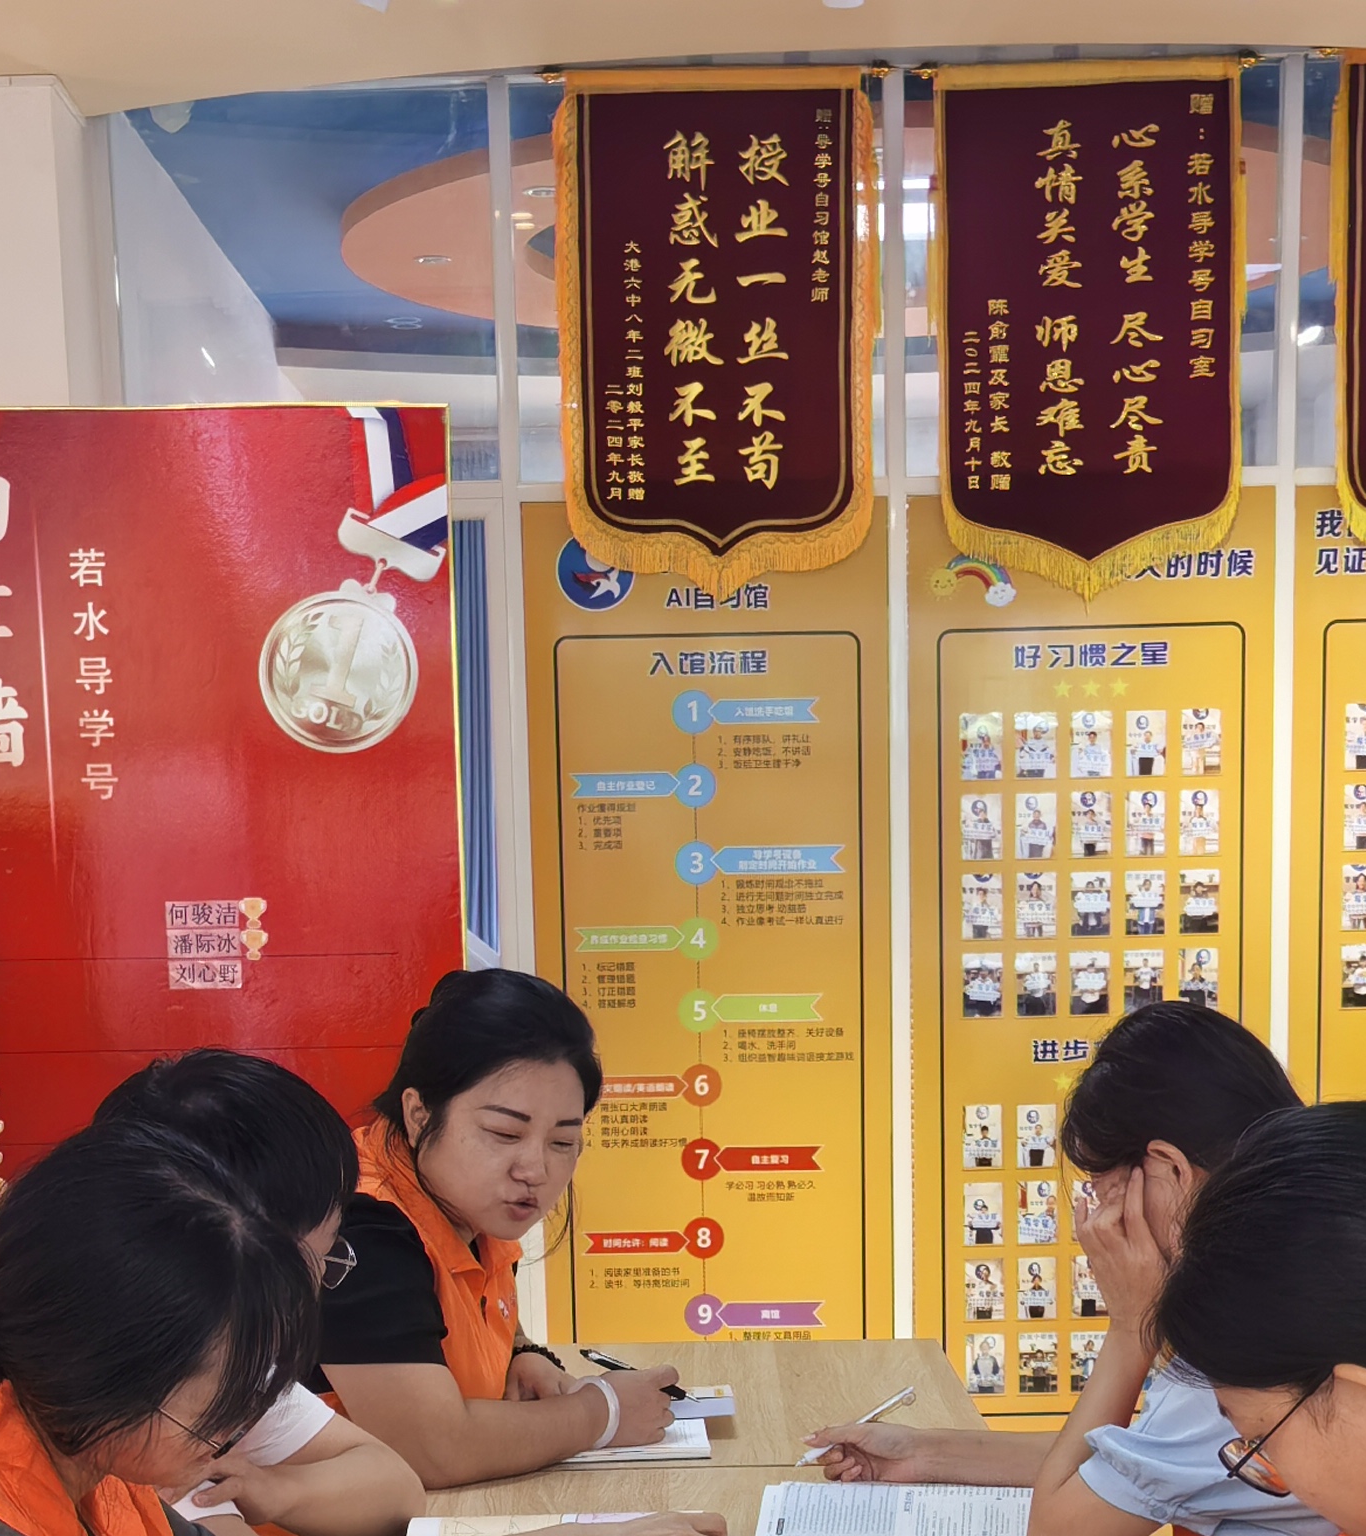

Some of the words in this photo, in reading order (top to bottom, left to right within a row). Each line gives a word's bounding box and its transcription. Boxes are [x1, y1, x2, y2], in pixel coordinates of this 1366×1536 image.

[1034, 118, 1084, 290] 真情关爱
[1111, 122, 1160, 285] 心系学生
[663, 130, 725, 487] 解惑无微不至
[734, 133, 790, 491] 授业一丝不苟
[1035, 313, 1084, 478] 师恩难忘
[1109, 311, 1164, 475] 尽心尽责
[605, 384, 625, 501] 二零二四年九月
[649, 650, 768, 676] 入馆流程
[1014, 642, 1169, 669] 好习惯之星
[68, 547, 119, 801] 若水导学号
[687, 700, 698, 722] 1
[688, 774, 702, 796] 2
[690, 851, 704, 874] 3
[168, 903, 237, 926] 何骏洁
[173, 933, 237, 955] 潘际冰
[690, 927, 706, 949] 4
[175, 964, 238, 984] 刘心野
[693, 1000, 707, 1022] 5
[694, 1074, 710, 1096] 6
[695, 1149, 710, 1170] 7
[696, 1227, 712, 1249] 8
[697, 1303, 713, 1325] 9
